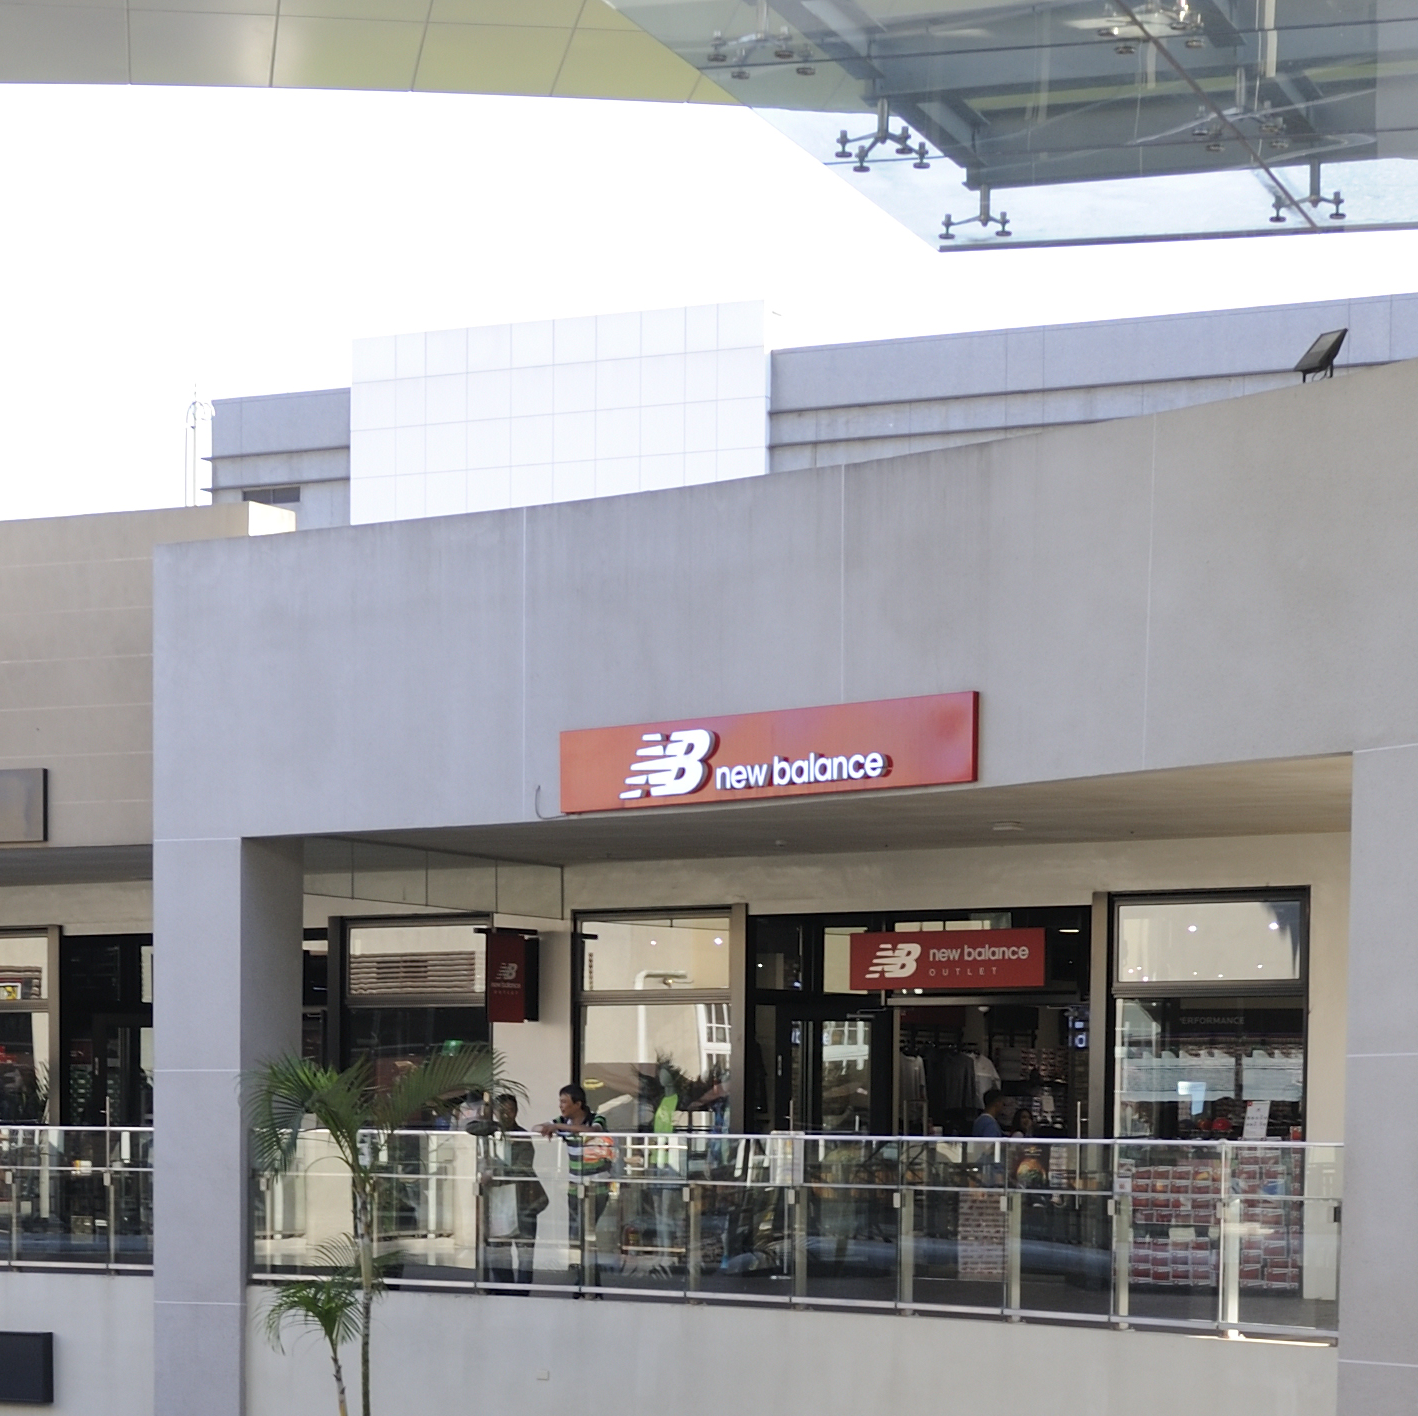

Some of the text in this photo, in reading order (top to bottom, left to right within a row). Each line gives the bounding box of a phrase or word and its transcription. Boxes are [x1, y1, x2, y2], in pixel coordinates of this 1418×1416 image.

[716, 764, 768, 790] new
[773, 751, 885, 786] balance
[929, 949, 960, 961] new
[964, 945, 1029, 961] balance
[929, 967, 997, 976] OUTLET
[1180, 1016, 1245, 1025] ERFORMANCE
